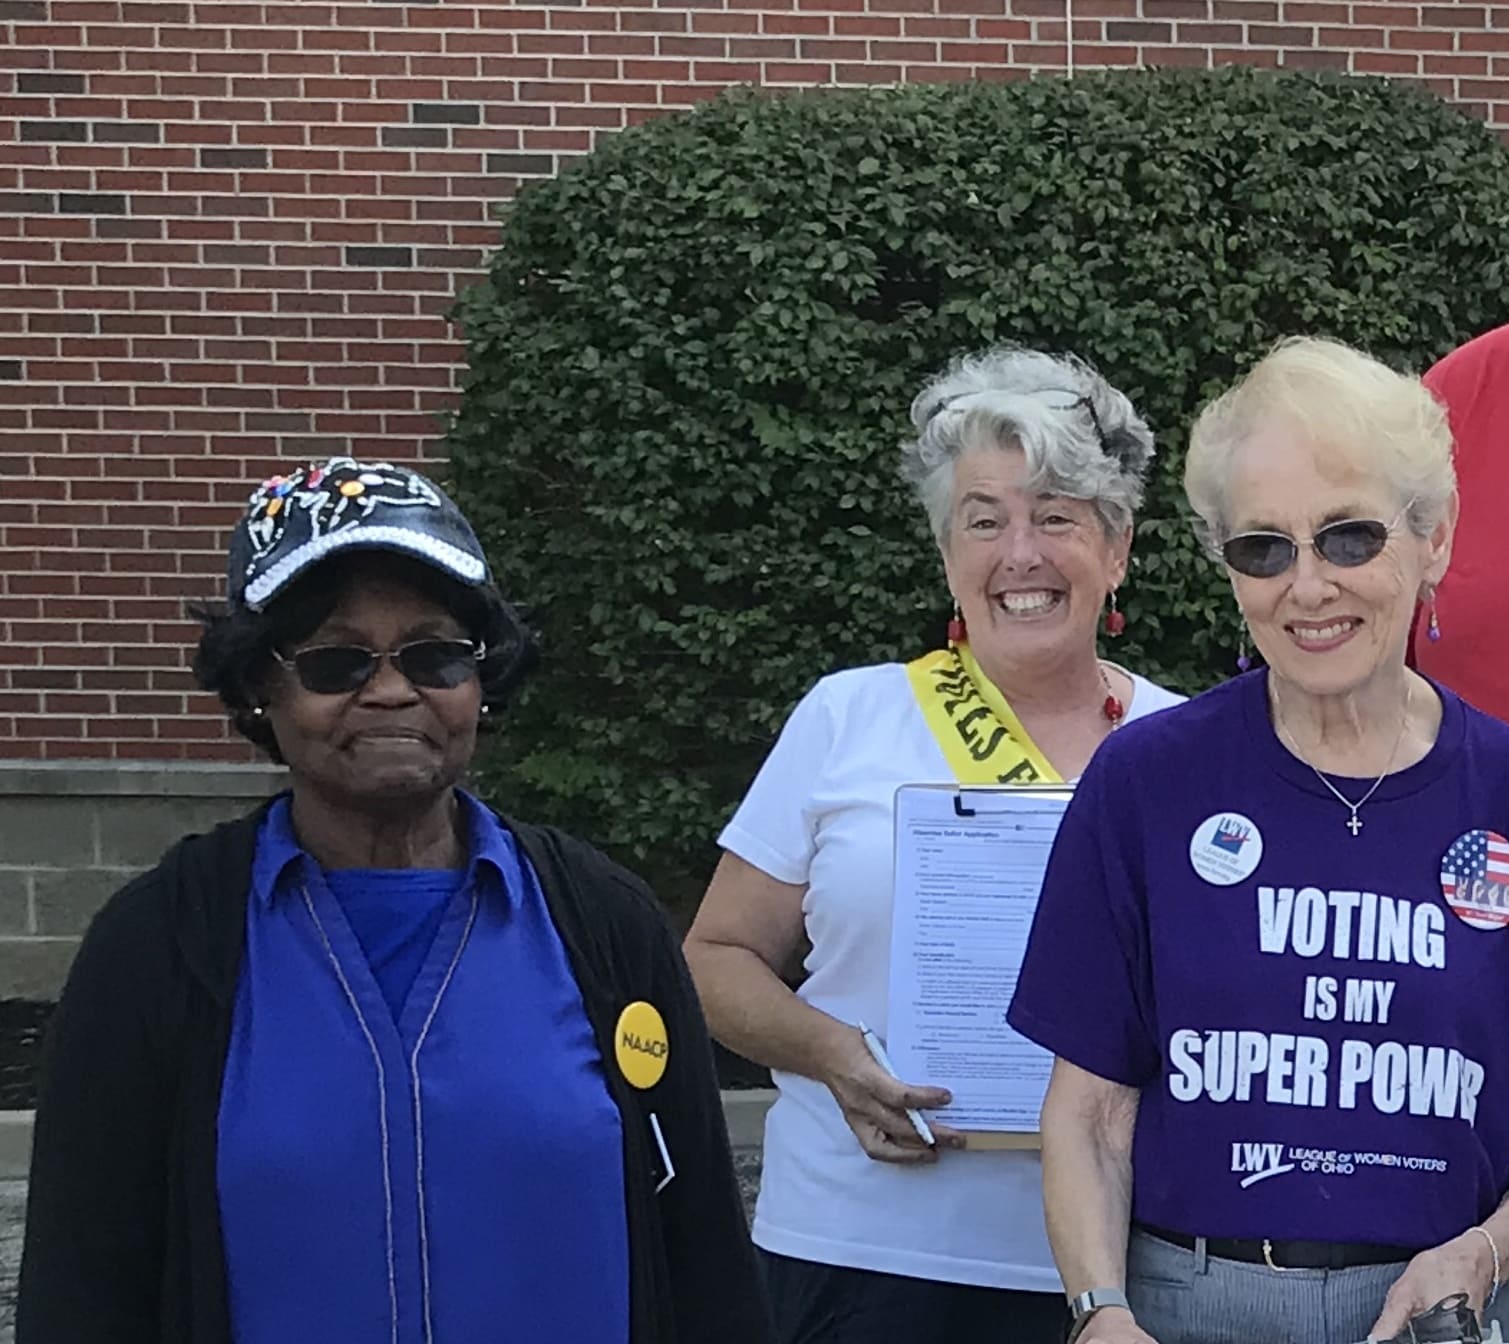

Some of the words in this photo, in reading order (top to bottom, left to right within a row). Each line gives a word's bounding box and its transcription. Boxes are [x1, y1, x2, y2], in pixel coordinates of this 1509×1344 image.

[1257, 886, 1446, 969] VOTING
[1304, 976, 1337, 1021] IS
[1344, 978, 1396, 1024] MY
[622, 1032, 668, 1059] NAACP
[1169, 1029, 1329, 1107] SUPER
[1339, 1039, 1485, 1128] POWR
[1231, 1142, 1285, 1173] LWV
[1288, 1148, 1337, 1163] LEAGUE
[1353, 1152, 1402, 1168] WOMEN
[1402, 1156, 1448, 1173] VOTERS
[1301, 1161, 1319, 1172] OF
[1321, 1161, 1355, 1175] OHIO
